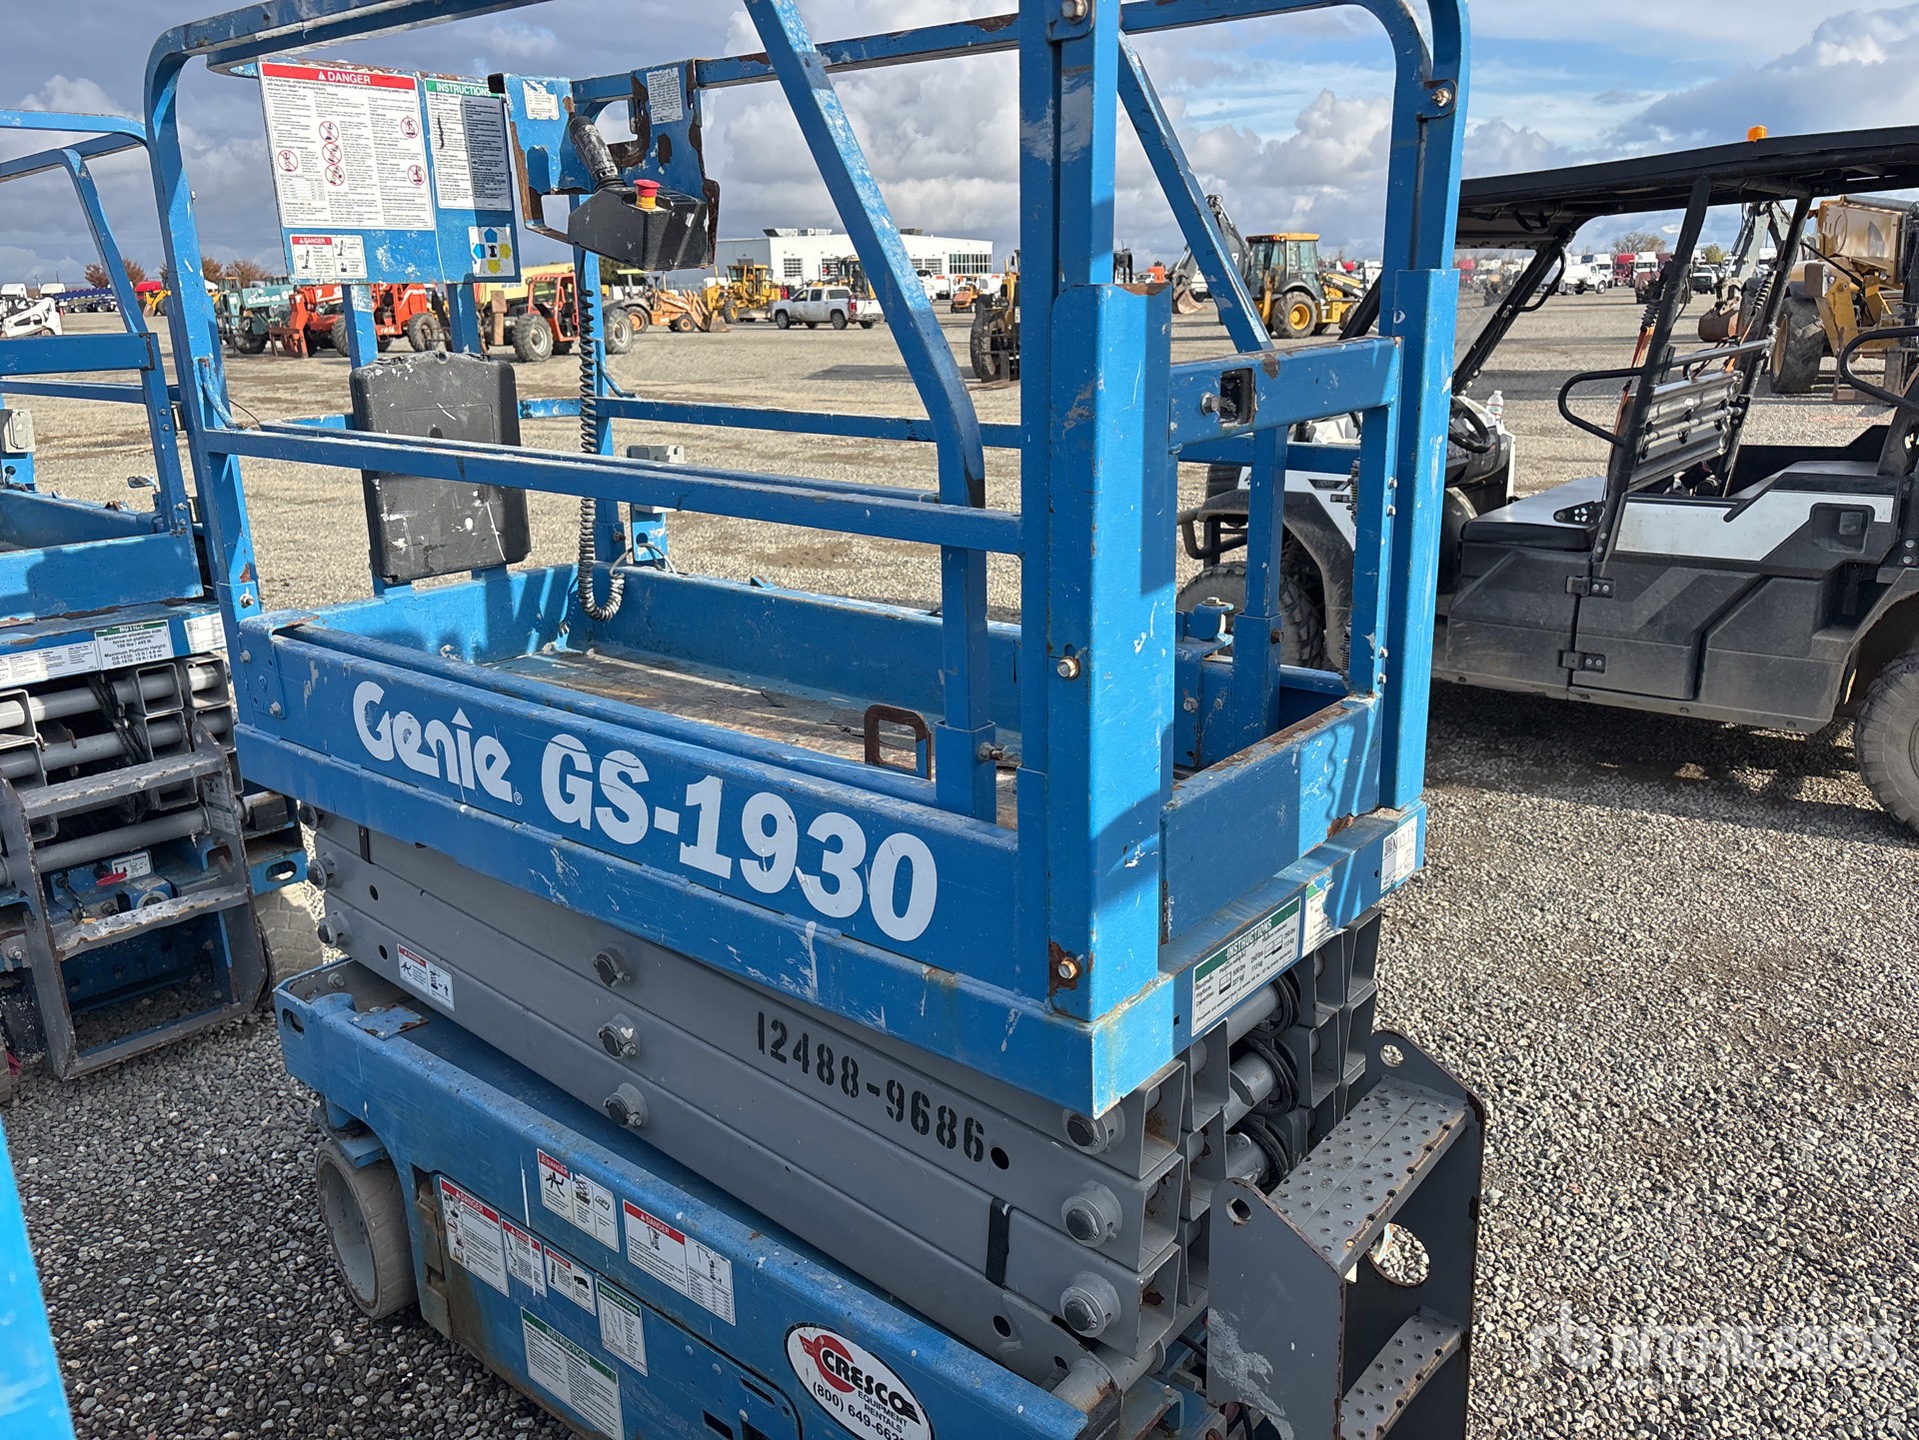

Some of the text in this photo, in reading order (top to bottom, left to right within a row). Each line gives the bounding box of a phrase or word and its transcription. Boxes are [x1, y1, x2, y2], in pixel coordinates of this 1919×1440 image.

[328, 72, 371, 85] DANGER
[436, 82, 492, 96] INSTRUCTIONS
[353, 681, 938, 942] Genie GS-1930
[1226, 918, 1272, 960] INSTRUCTIONS
[757, 1011, 985, 1163] 12488-9686
[460, 1192, 484, 1213] DANGER
[646, 1216, 670, 1235] DANGER
[600, 1285, 638, 1315] INSTRUCTIONS
[546, 1326, 591, 1364] INSTRUCTIONS
[822, 1349, 919, 1424] CRESCO
[813, 1381, 905, 1440] (800) 649-662
[857, 1390, 908, 1427] EQUIPMENT
[864, 1403, 903, 1434] RENTALS
